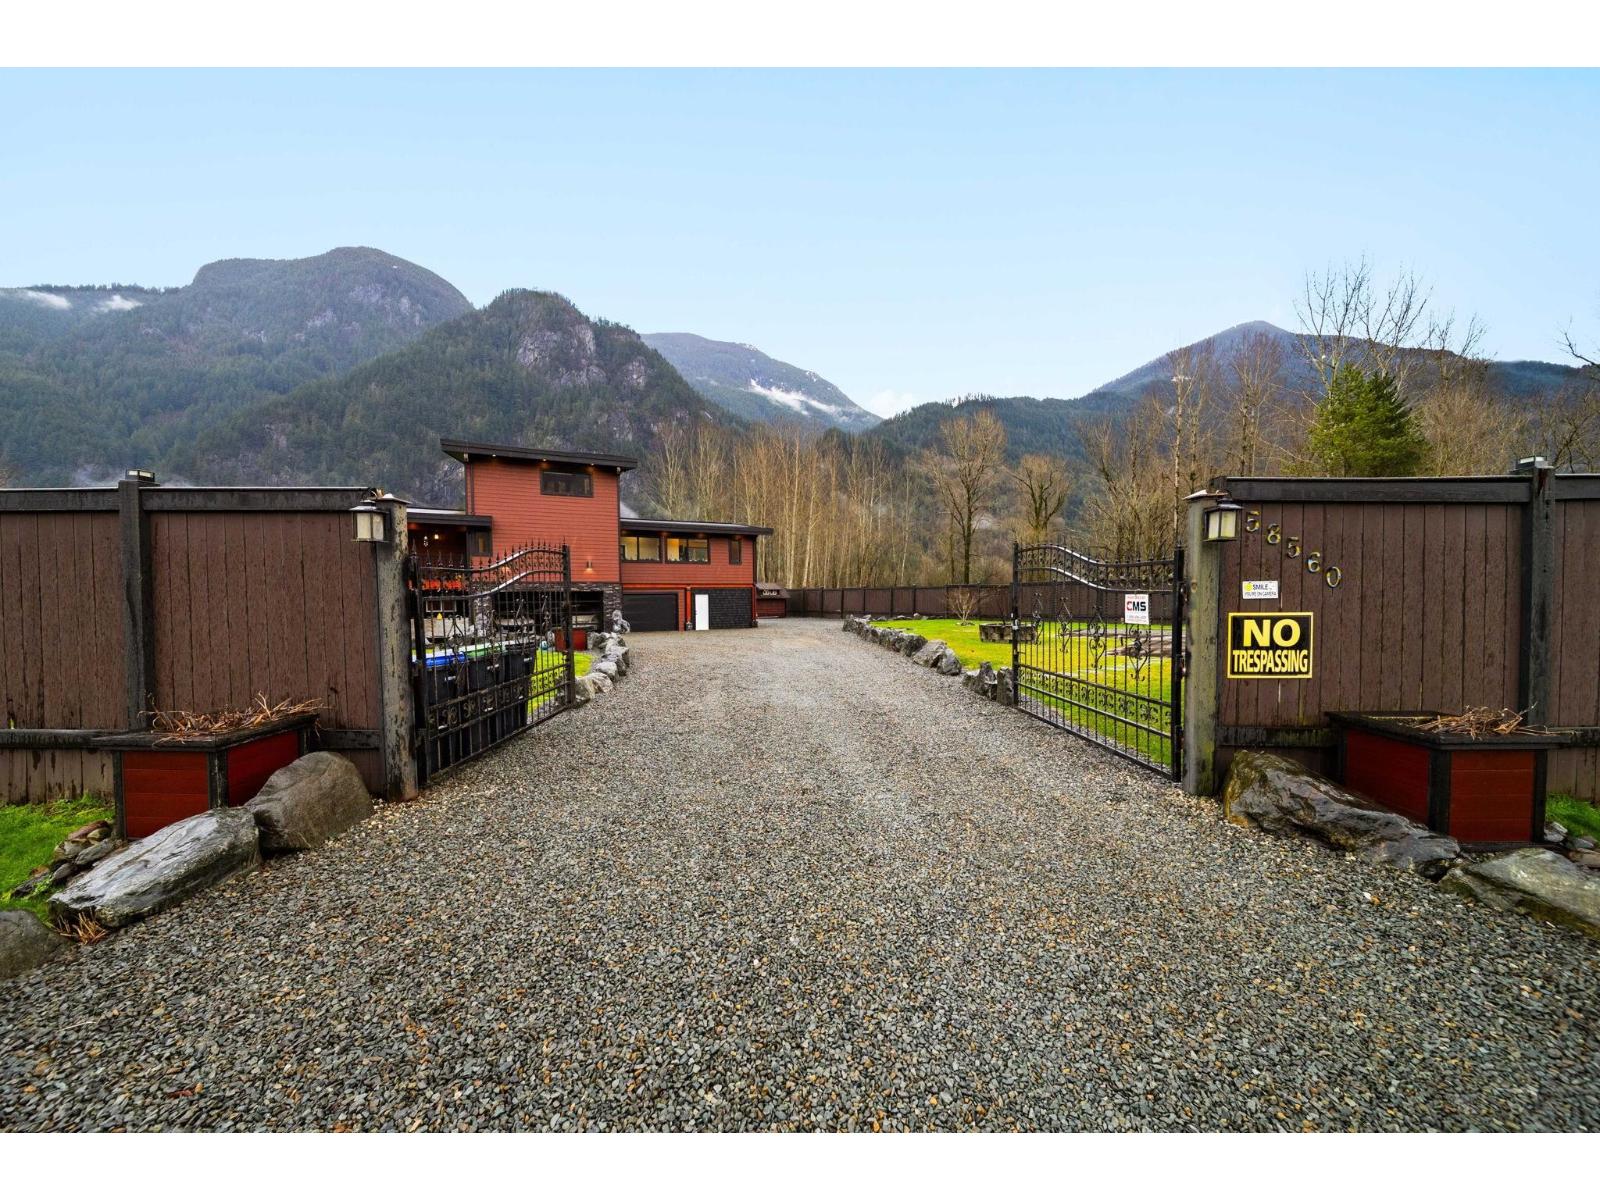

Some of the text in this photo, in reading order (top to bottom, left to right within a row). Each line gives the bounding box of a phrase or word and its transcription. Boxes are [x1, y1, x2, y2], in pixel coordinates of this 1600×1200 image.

[1246, 510, 1341, 588] 58560
[1127, 601, 1147, 611] CMS
[1243, 619, 1301, 647] NO
[1232, 649, 1308, 673] TRESPASSING
